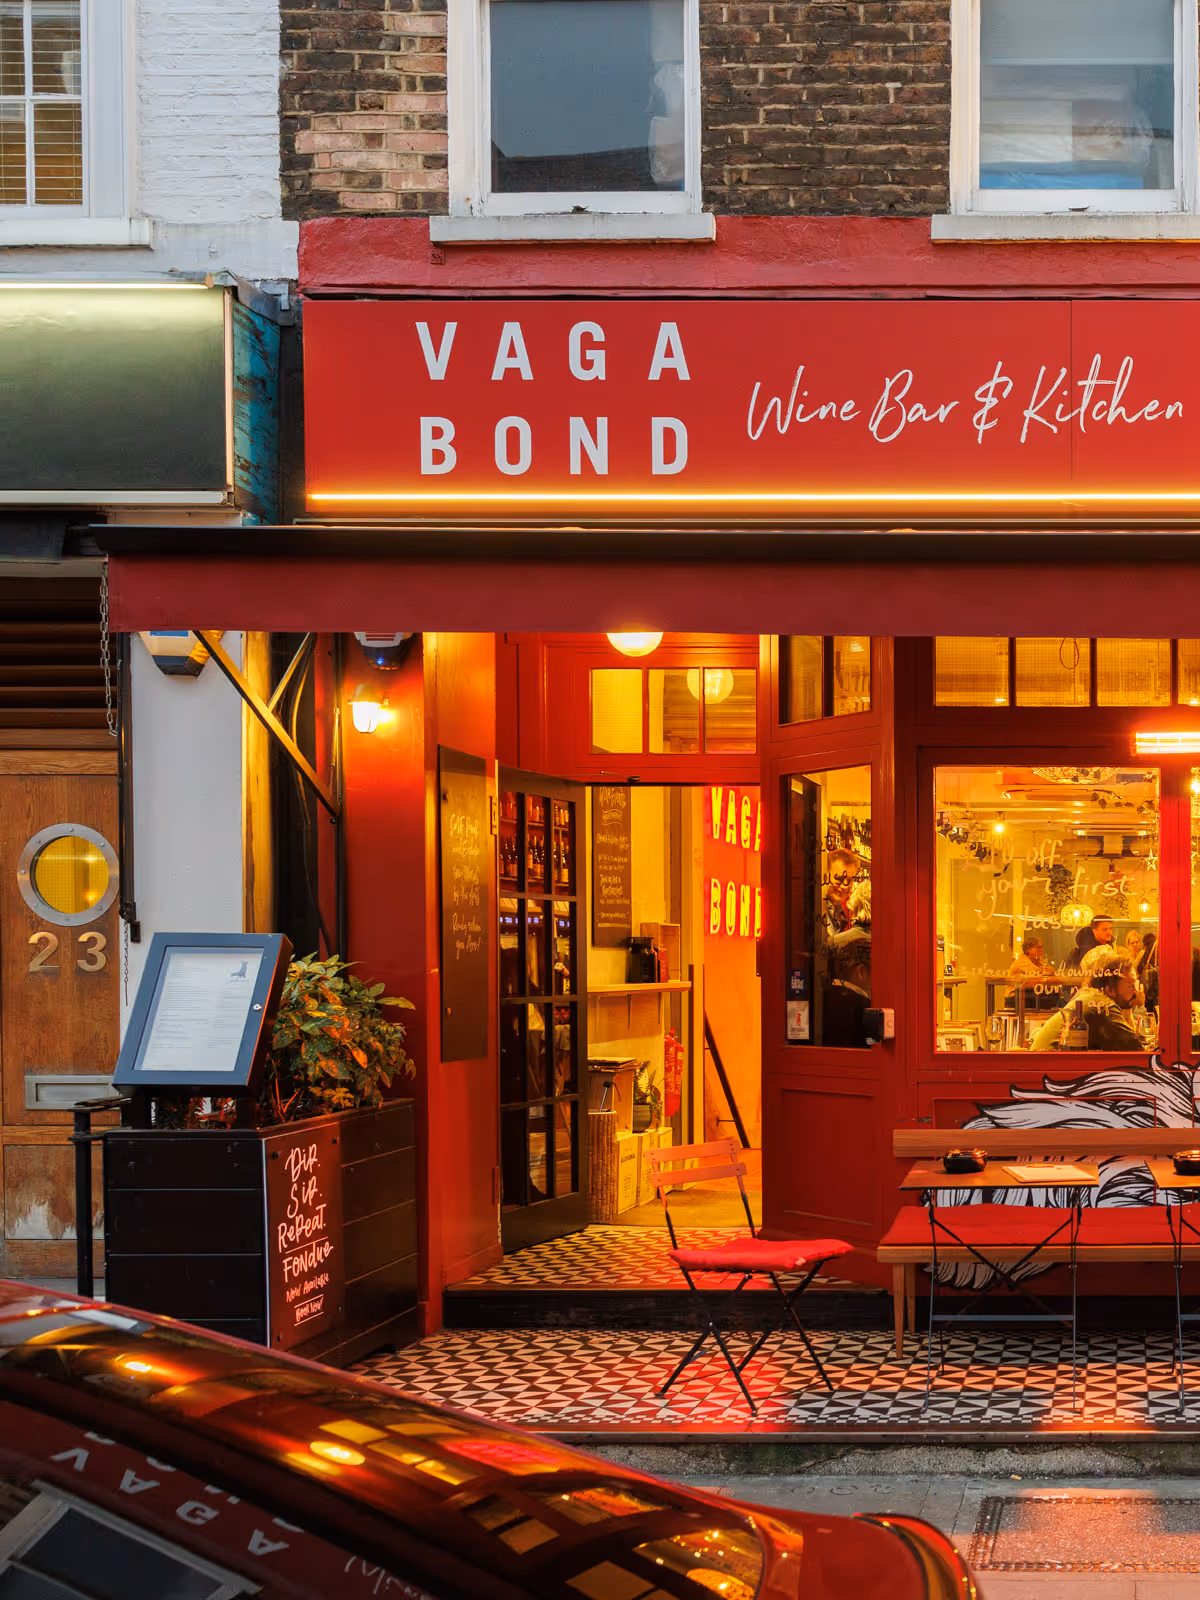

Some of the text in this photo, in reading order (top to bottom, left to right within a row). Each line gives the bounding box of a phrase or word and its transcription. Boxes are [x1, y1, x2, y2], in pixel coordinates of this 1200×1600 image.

[415, 321, 691, 381] VAGA
[747, 353, 1183, 445] Wine Bar & Kitchen
[420, 415, 688, 476] BOND
[1027, 838, 1063, 869] off
[977, 866, 1137, 921] your first
[28, 931, 108, 973] 23
[1054, 959, 1123, 978] download
[1034, 984, 1062, 996] our
[284, 1143, 321, 1183] Dip.
[287, 1175, 323, 1219] Sip.
